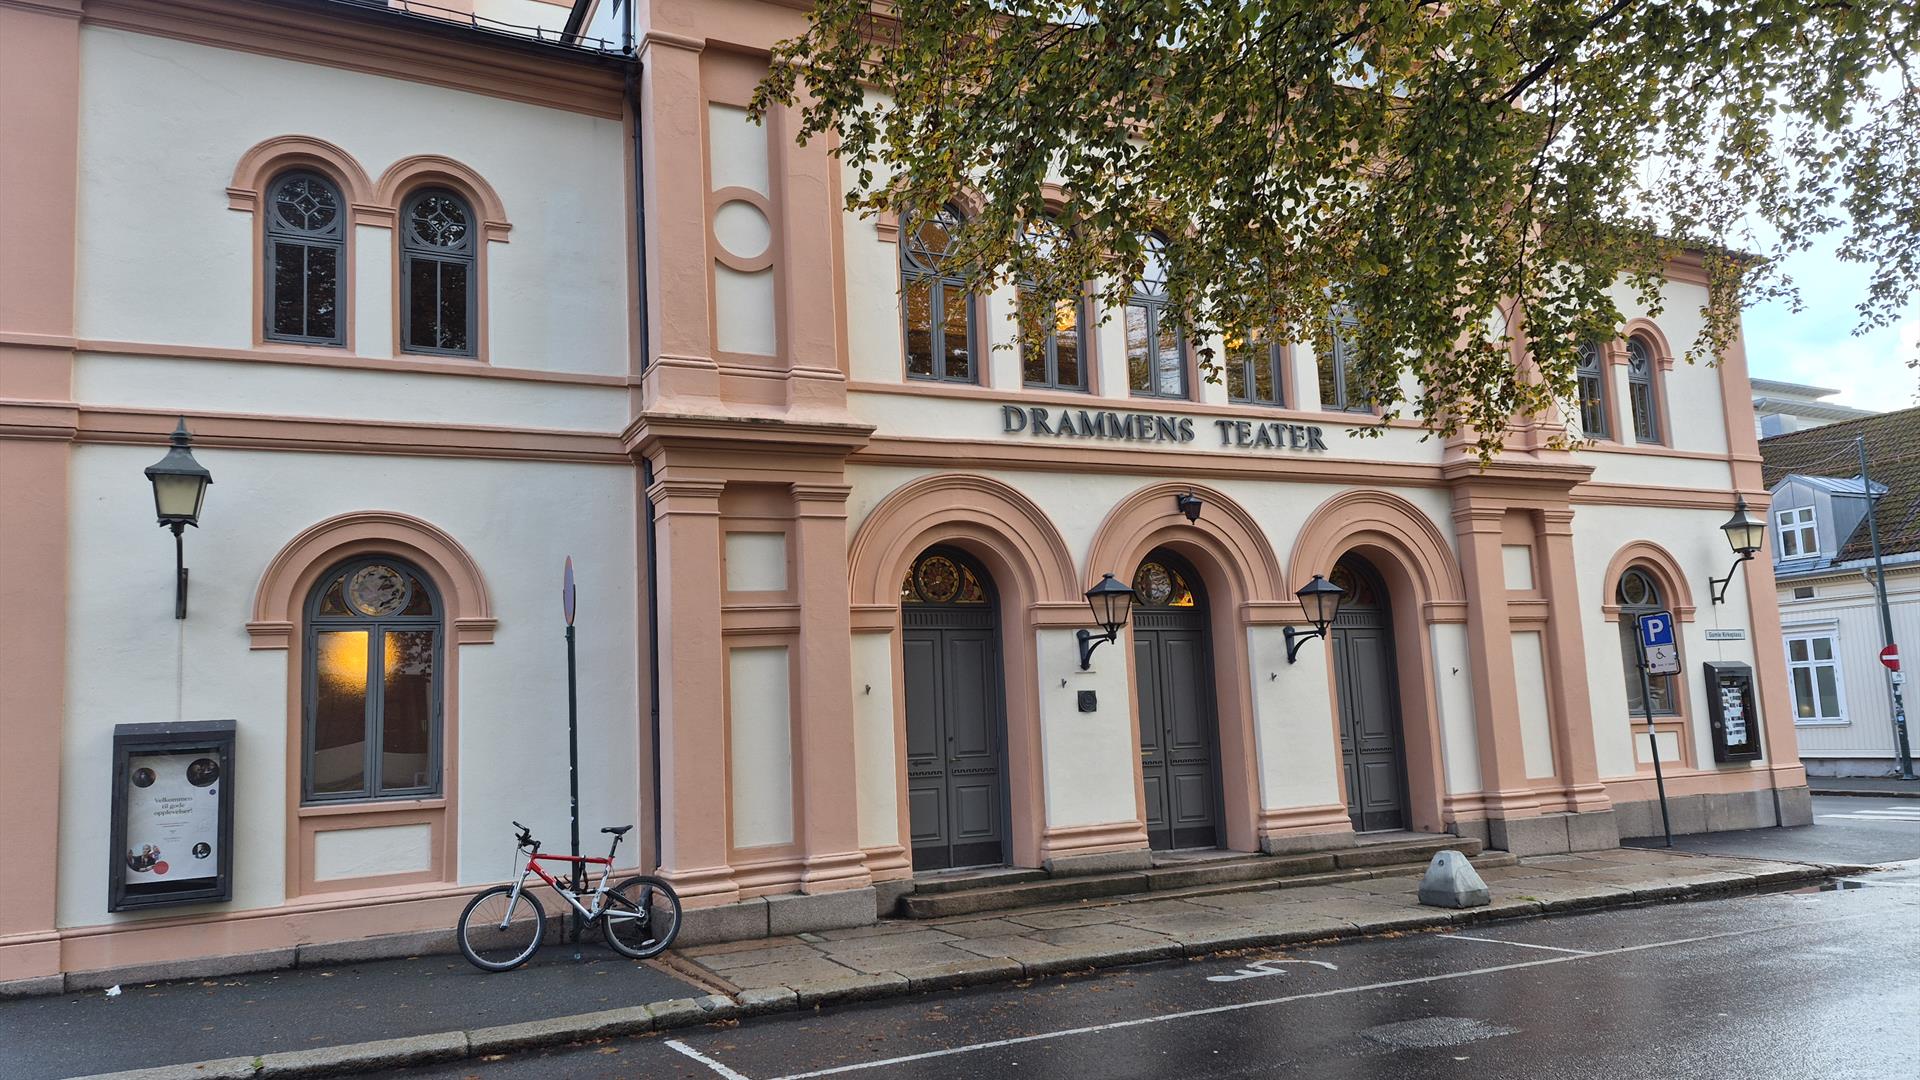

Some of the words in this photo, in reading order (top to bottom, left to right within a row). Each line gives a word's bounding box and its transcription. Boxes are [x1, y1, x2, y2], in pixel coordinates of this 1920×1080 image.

[1002, 405, 1195, 442] DRAMMENS
[1215, 420, 1329, 451] TEATER
[1648, 619, 1664, 642] P
